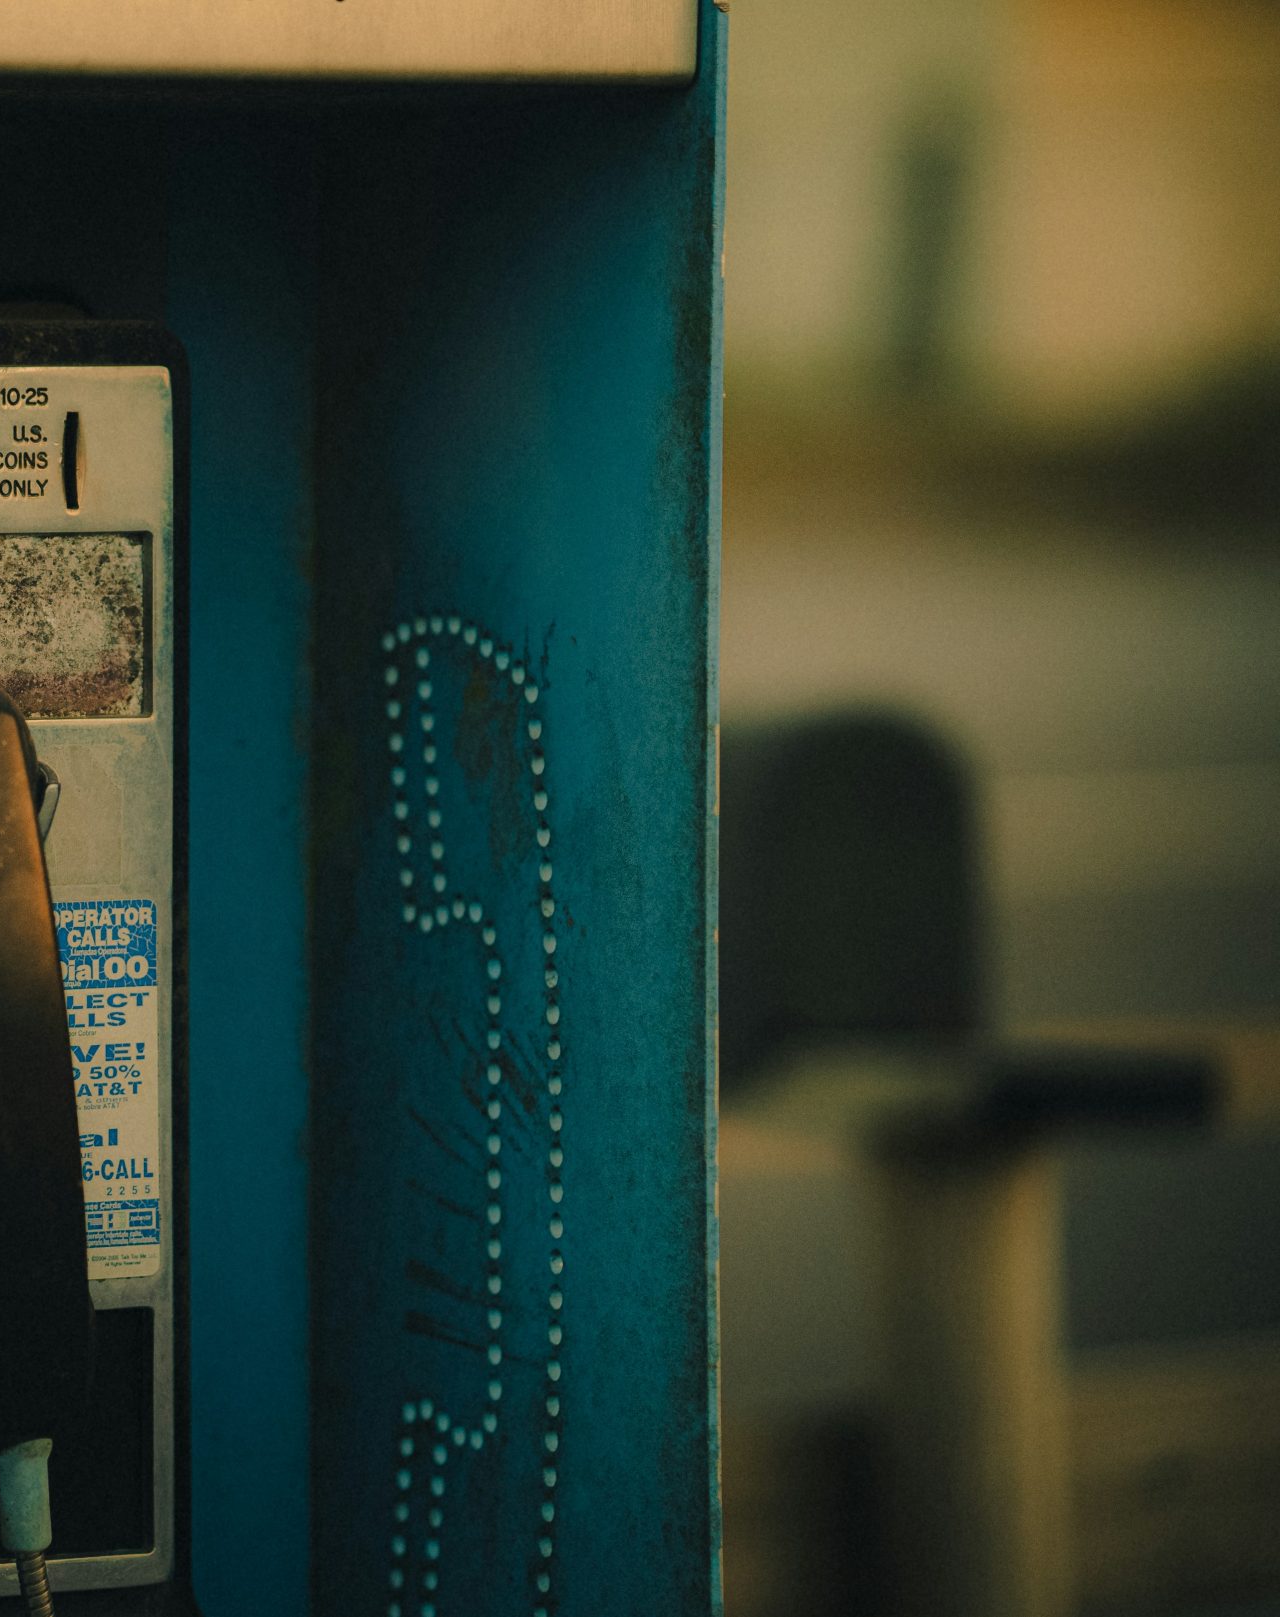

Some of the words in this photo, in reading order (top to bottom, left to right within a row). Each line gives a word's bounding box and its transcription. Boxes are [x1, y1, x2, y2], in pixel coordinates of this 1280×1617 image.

[13, 425, 48, 443] U.S.
[0, 479, 49, 497] ONLY
[67, 928, 131, 947] CALLS
[66, 992, 150, 1010] LECT
[68, 1012, 126, 1028] LLS
[71, 1043, 145, 1063] VE!
[90, 1064, 141, 1080] 50%
[77, 1081, 142, 1097] AT&T
[80, 1128, 118, 1148] al
[82, 1157, 154, 1182] 6-CALL
